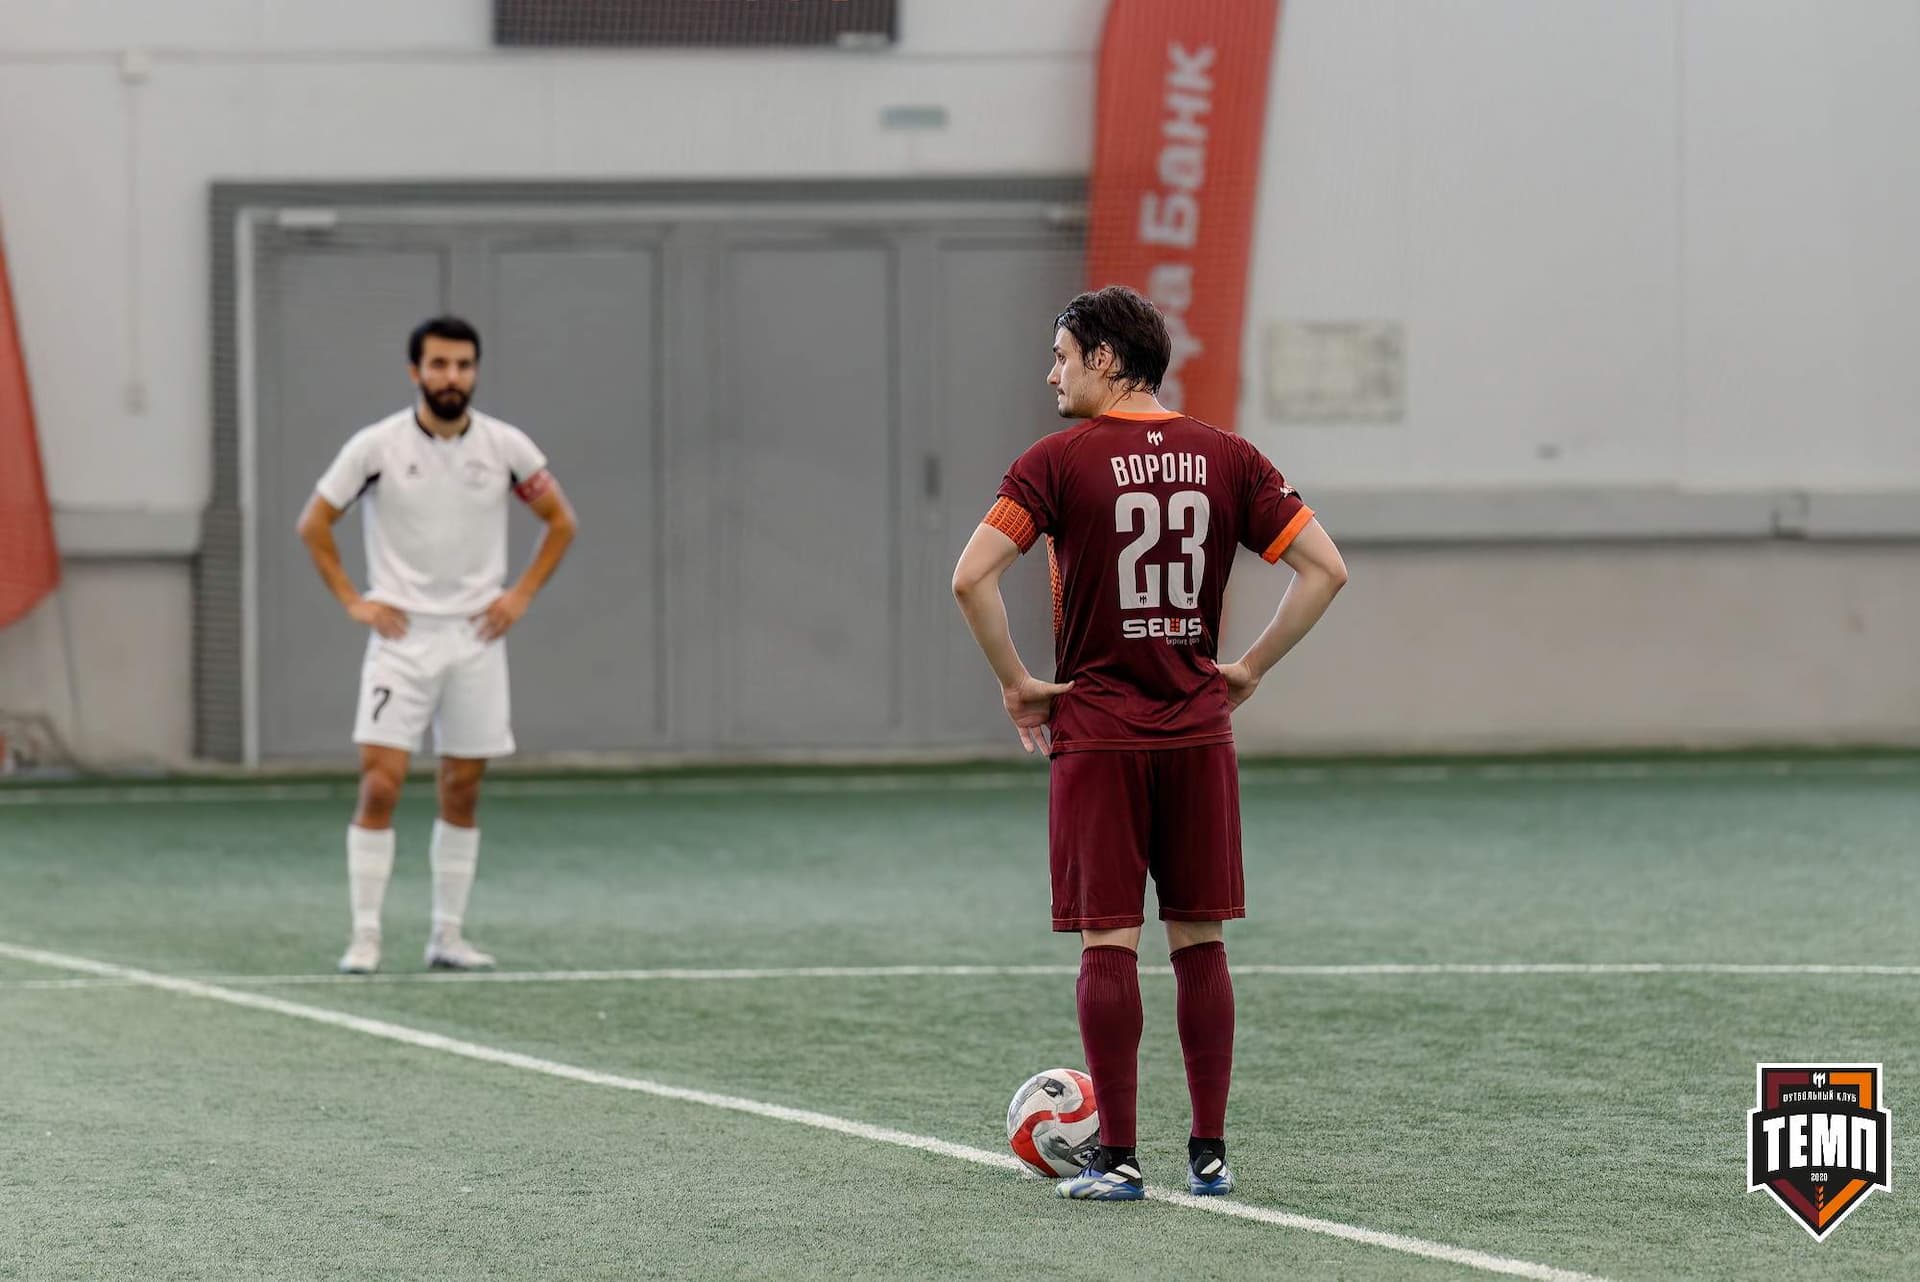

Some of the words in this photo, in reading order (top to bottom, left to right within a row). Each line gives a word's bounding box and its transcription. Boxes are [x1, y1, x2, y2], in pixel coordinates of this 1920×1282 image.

[1139, 41, 1216, 248] Банк
[1110, 452, 1208, 487] ВОРОНА
[1115, 490, 1210, 610] 23
[1122, 617, 1202, 639] SEUS
[371, 686, 392, 722] 7
